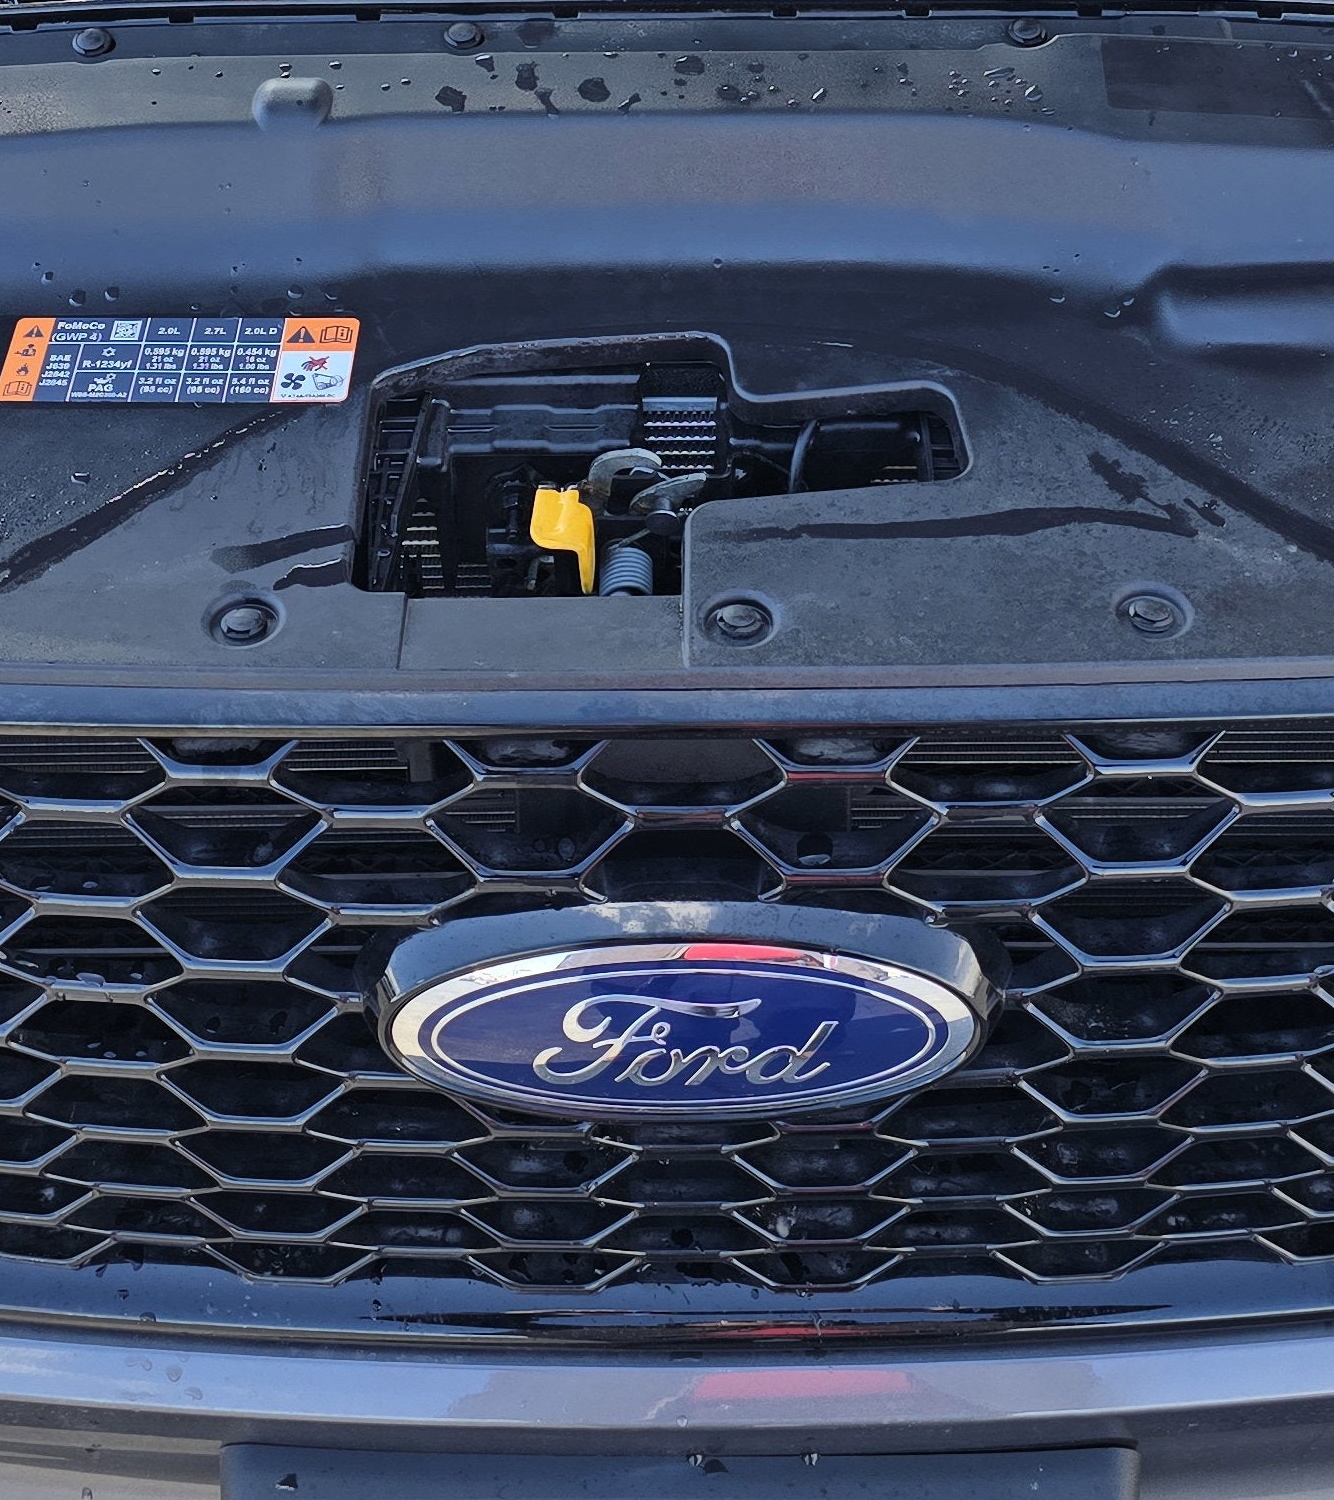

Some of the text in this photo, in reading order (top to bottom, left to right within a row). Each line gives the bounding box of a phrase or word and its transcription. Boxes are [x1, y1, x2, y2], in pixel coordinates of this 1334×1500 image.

[57, 321, 106, 330] FoMoCo
[157, 327, 181, 335] 2.0L
[203, 327, 227, 335] 2.7L
[244, 327, 278, 335] 2.0L D
[51, 332, 103, 342] (GWP 4)
[172, 347, 185, 357] kg
[218, 347, 231, 357] kg
[265, 347, 277, 357] kg
[82, 360, 133, 370] R-1234yf
[138, 377, 153, 385] 3.2
[186, 377, 201, 385] 3.2
[231, 377, 246, 385] 5.4
[156, 385, 173, 394] cc)
[204, 385, 221, 395] cc)
[252, 385, 269, 395] cc)
[532, 992, 839, 1087] Ford
